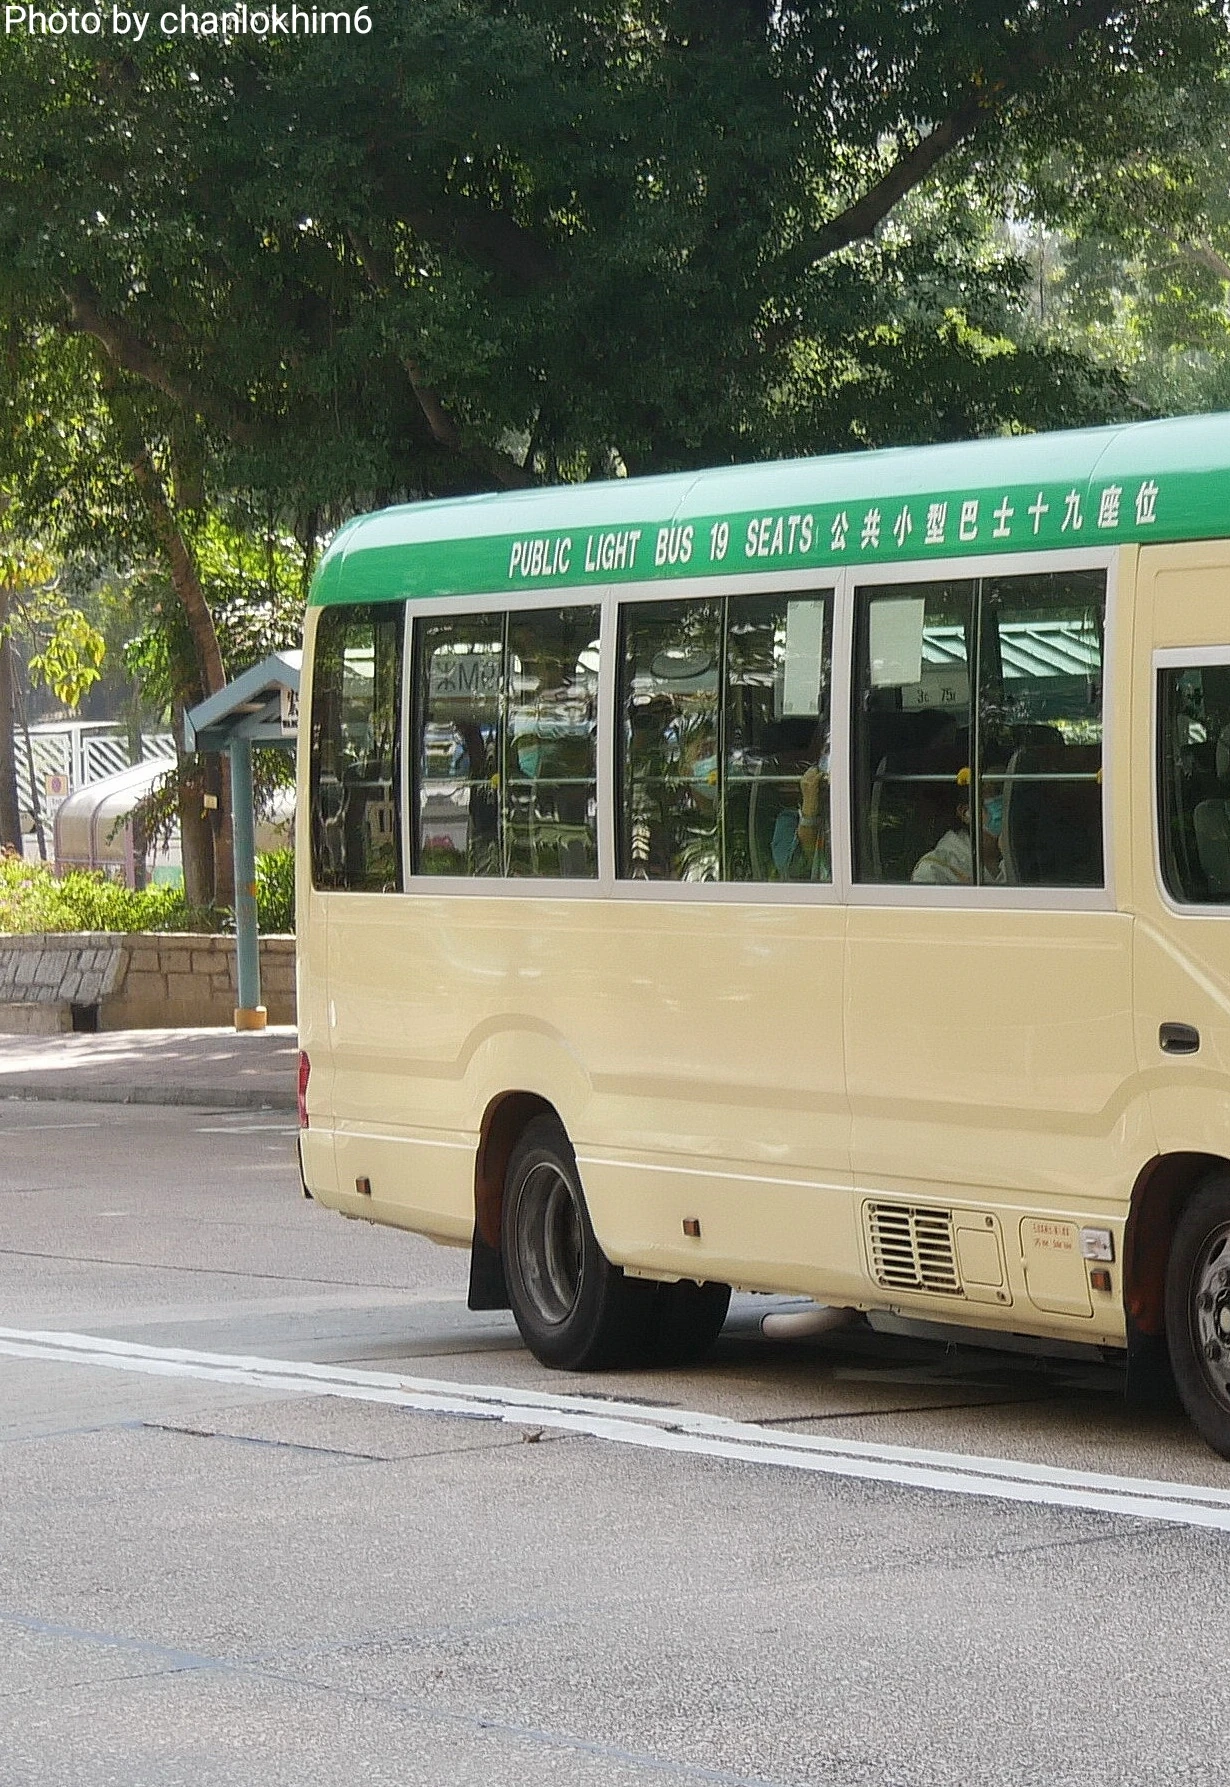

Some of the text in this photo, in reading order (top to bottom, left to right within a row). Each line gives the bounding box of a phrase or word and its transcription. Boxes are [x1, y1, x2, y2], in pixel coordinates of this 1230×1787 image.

[508, 513, 814, 579] PUBLIC LIGHT BUS 19 SEATS
[831, 479, 1159, 551] 公共小型巴士十九座位
